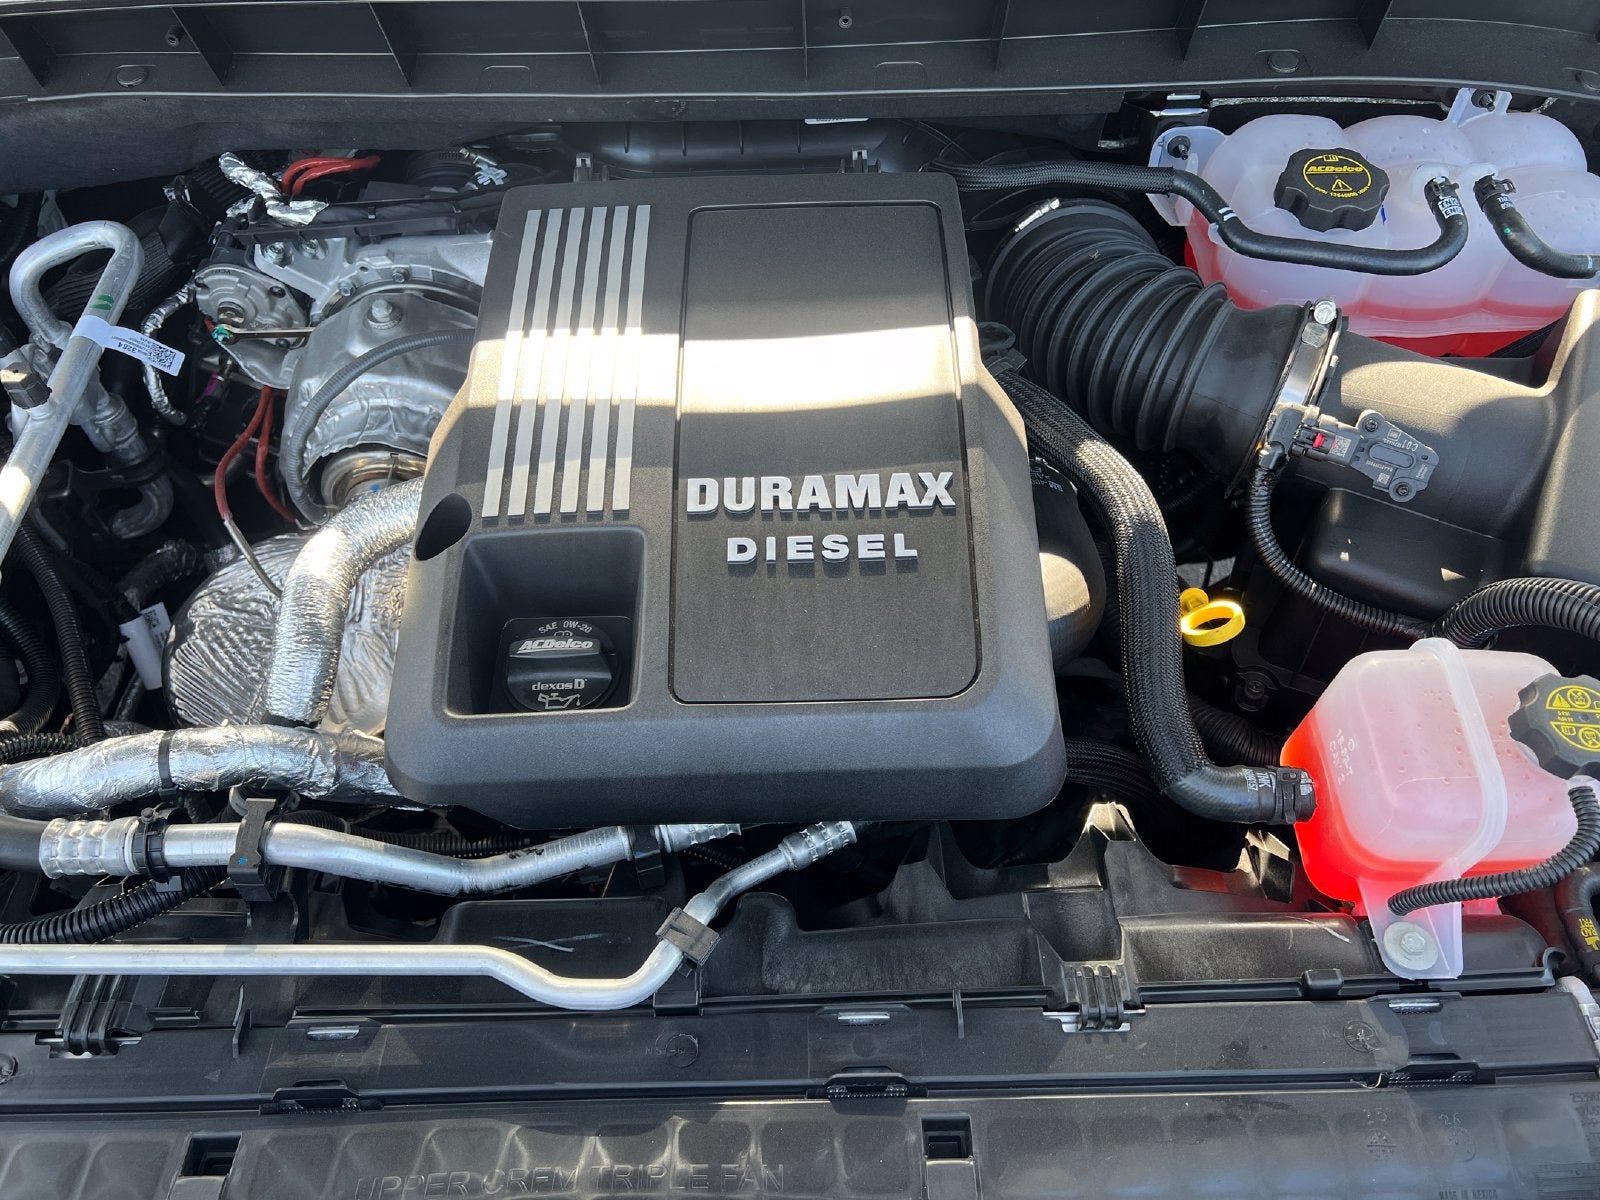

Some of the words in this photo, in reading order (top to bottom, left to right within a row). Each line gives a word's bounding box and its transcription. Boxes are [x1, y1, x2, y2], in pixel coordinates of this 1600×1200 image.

[1306, 165, 1364, 173] ACDelco
[686, 472, 956, 513] DURAMAX
[727, 533, 918, 564] DIESEL
[538, 621, 558, 634] SAE
[562, 620, 593, 634] 0W-20
[517, 638, 594, 654] ACDelco
[1257, 772, 1272, 788] TNK
[354, 1171, 470, 1200] UPPER
[590, 1164, 710, 1192] TRIPLE
[720, 1164, 785, 1193] FAN
